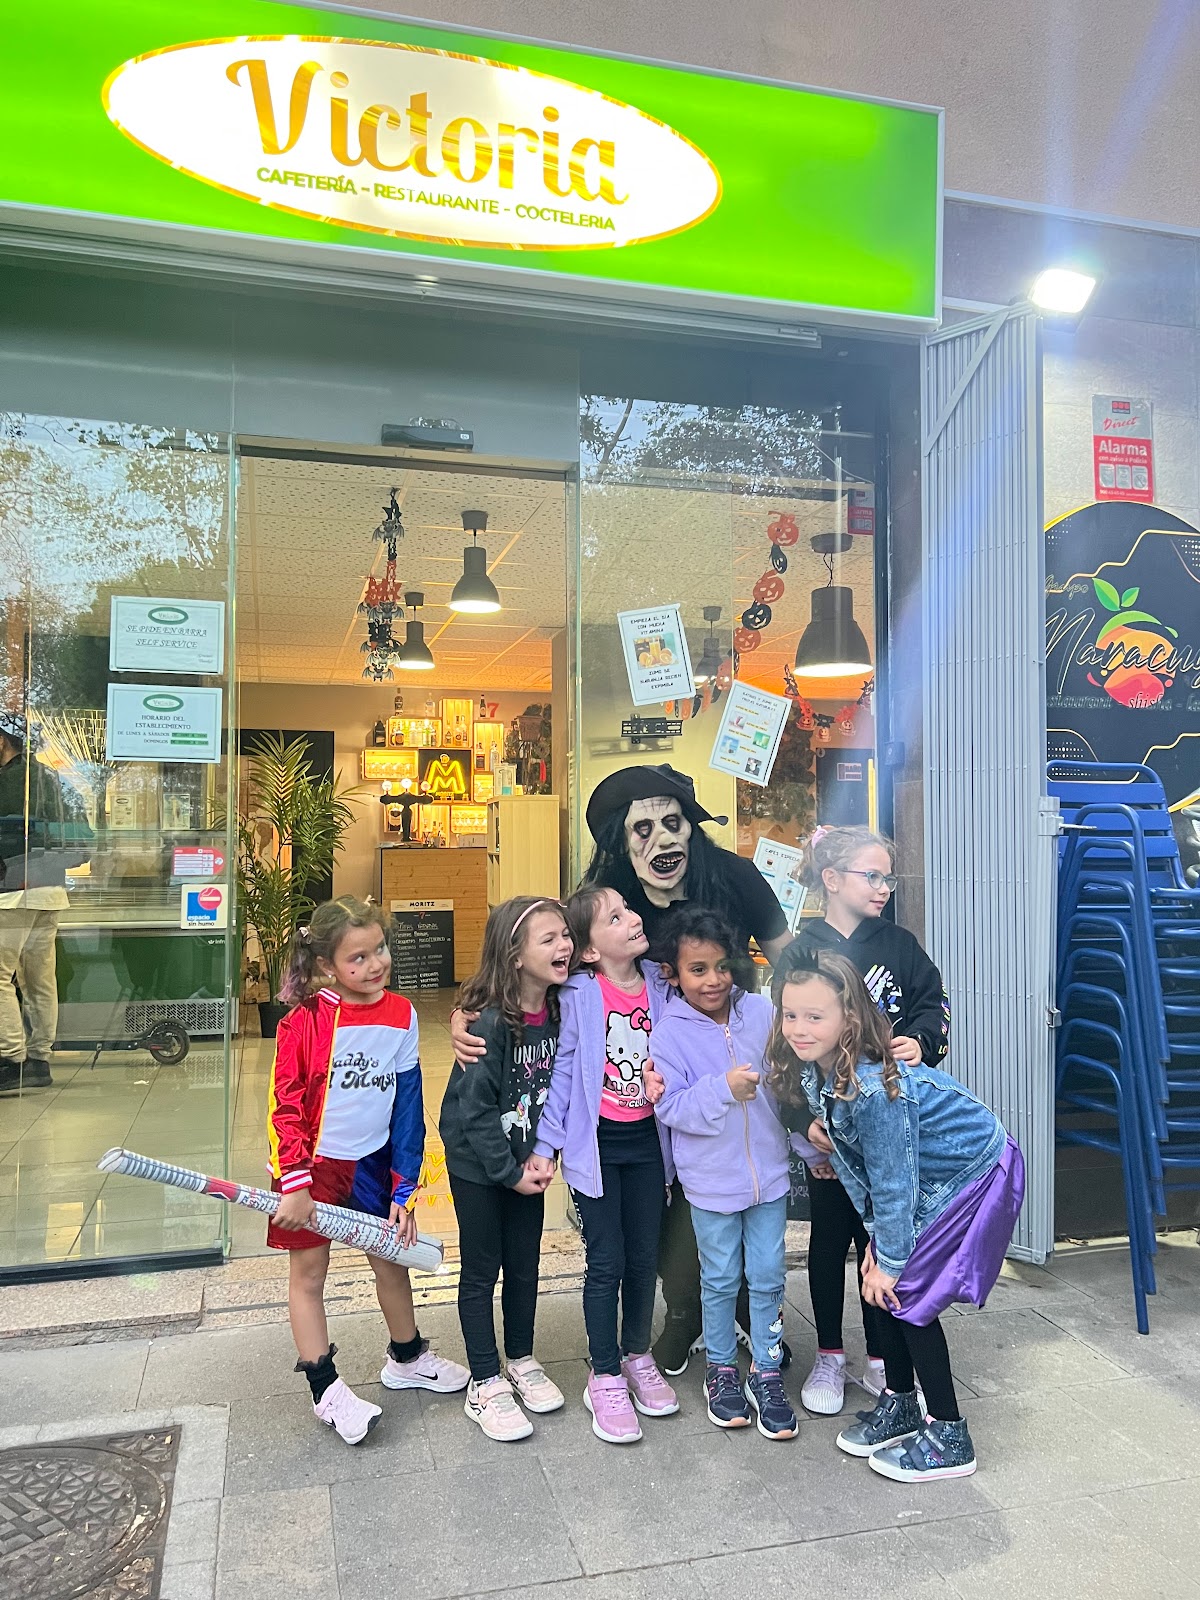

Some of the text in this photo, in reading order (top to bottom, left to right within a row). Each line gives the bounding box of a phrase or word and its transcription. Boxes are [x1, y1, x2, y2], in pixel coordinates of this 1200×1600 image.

[226, 58, 630, 206] Victoria
[256, 167, 358, 196] CAFETERÍA
[373, 184, 499, 215] RESTAURANTE
[515, 204, 616, 232] COCTELERIA
[1103, 416, 1141, 431] Direct
[1099, 440, 1147, 457] Alarma
[138, 625, 161, 634] PIDE
[178, 627, 207, 637] BARRA
[135, 638, 198, 649] SELF SERVICE
[486, 702, 499, 718] 7
[135, 722, 191, 730] ESTABLECIMIENTO
[332, 1051, 380, 1071] addy's
[628, 1098, 647, 1108] CLU
